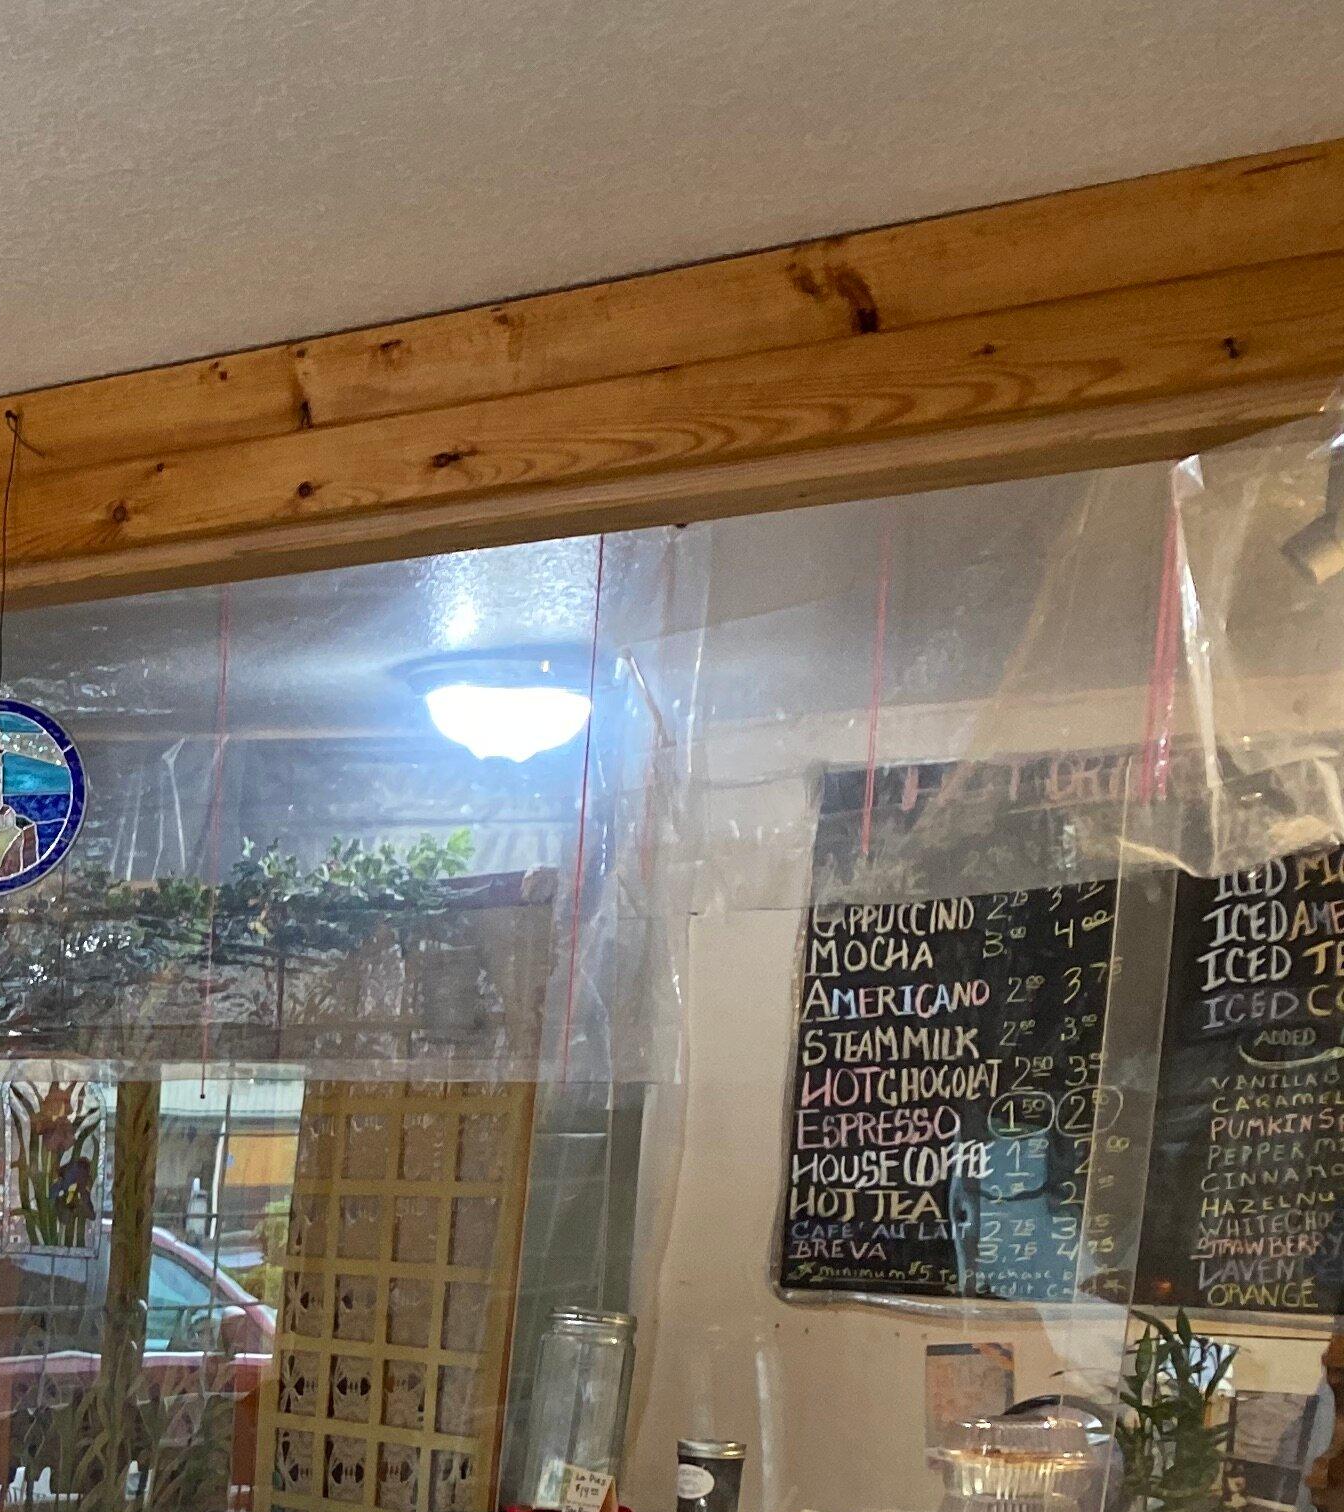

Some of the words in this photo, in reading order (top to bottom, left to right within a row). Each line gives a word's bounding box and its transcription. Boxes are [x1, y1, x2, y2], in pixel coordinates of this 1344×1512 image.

[1202, 899, 1289, 948] ICED
[805, 936, 935, 978] MOCHA
[1196, 944, 1293, 992] ICED
[800, 978, 991, 1023] AMERICANO
[1200, 990, 1300, 1031] ICED
[1254, 1026, 1317, 1047] ADDED
[1211, 1072, 1319, 1091] VANILLA
[1213, 1091, 1344, 1115] CARAMEL
[794, 1104, 961, 1150] ESPRESSO
[788, 1185, 856, 1224] HOT
[864, 1188, 949, 1225] TEA
[788, 1239, 888, 1261] BREVA
[1206, 1274, 1320, 1309] ORANGE
